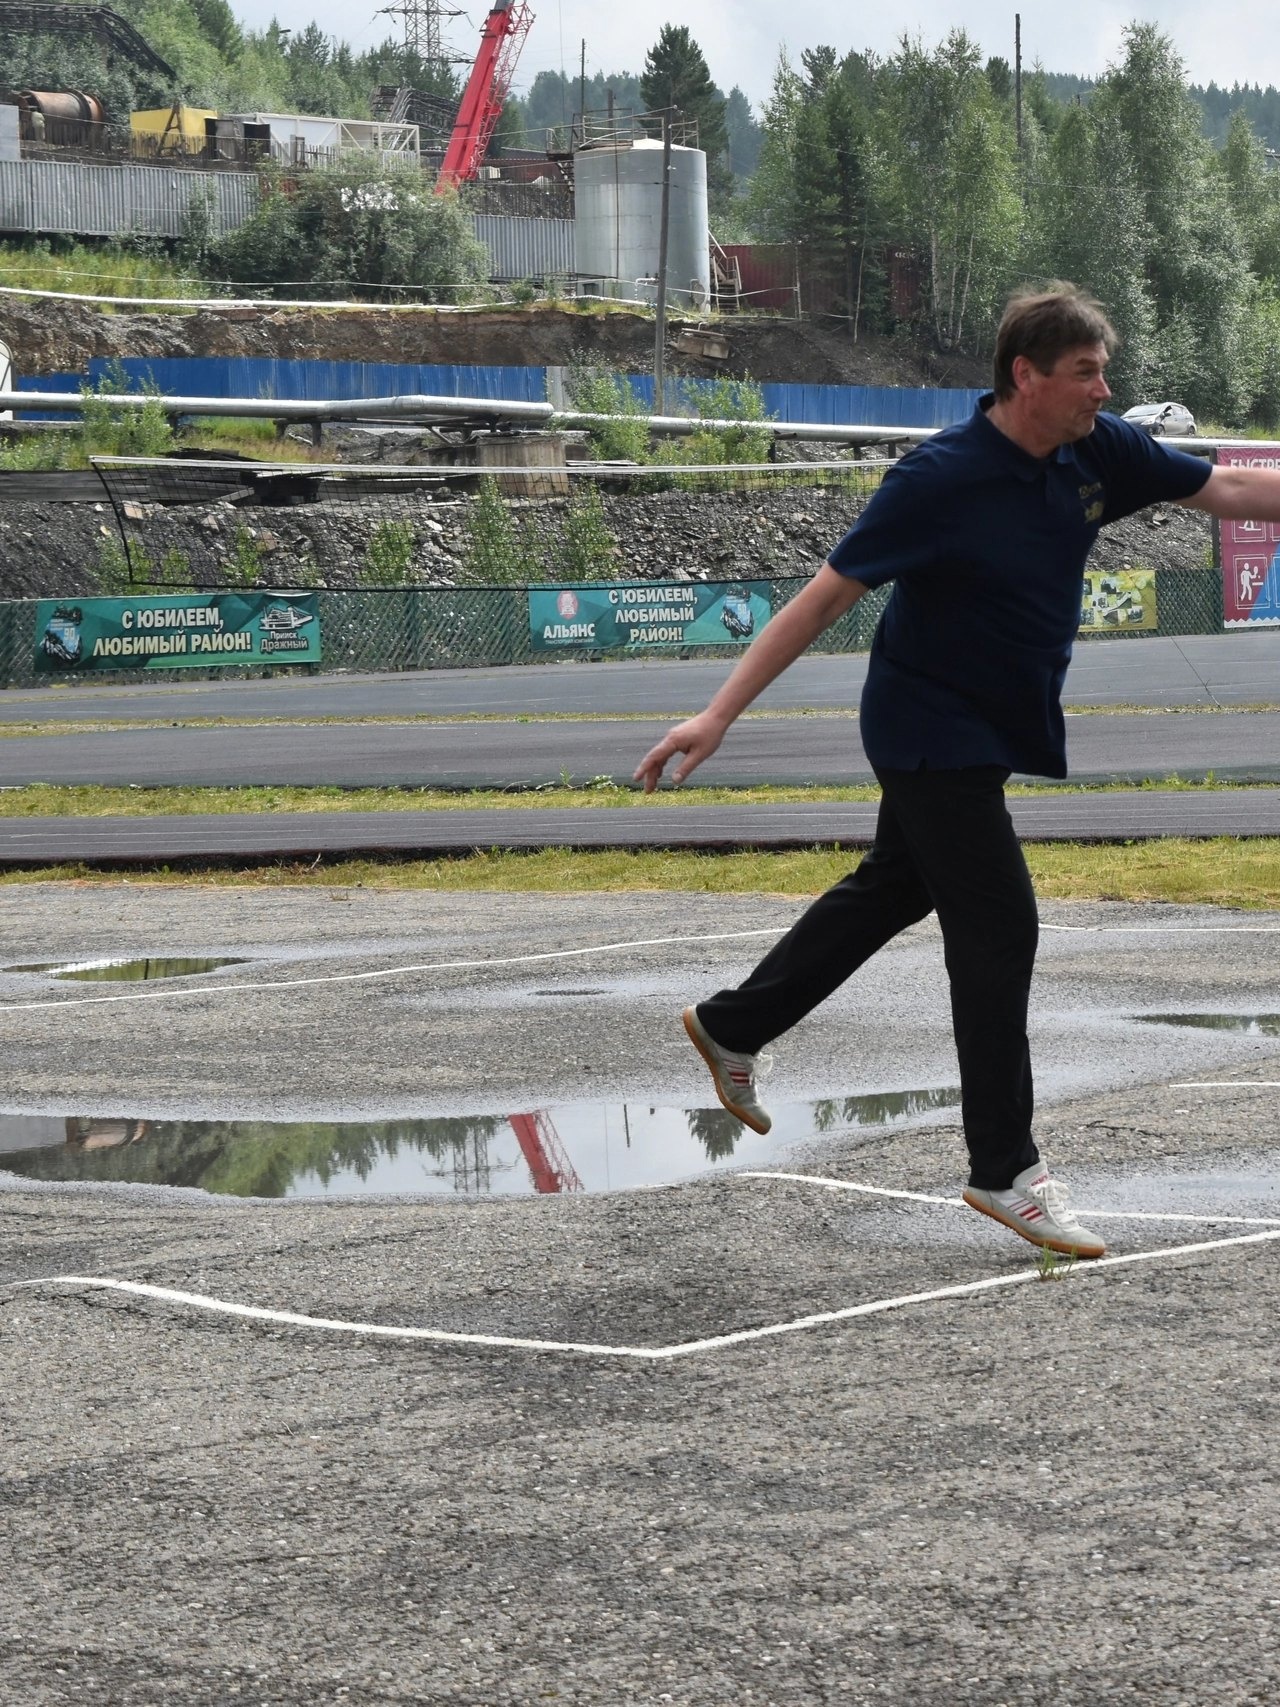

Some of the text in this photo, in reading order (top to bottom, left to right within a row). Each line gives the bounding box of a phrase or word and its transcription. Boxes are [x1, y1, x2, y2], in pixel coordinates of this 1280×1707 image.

[608, 587, 698, 604] С ЮБИЛЕЕМ,
[122, 607, 224, 629] С ЮБИЛЕЕМ,
[615, 603, 694, 623] ЛЮБИМЫЙ
[270, 631, 298, 641] Прииск
[543, 623, 596, 639] АЛЬЯНС
[629, 624, 683, 642] РАЙОН!
[93, 627, 251, 656] ЛЮБИМЫЙ РАЙОН!
[261, 637, 308, 652] Дражный
